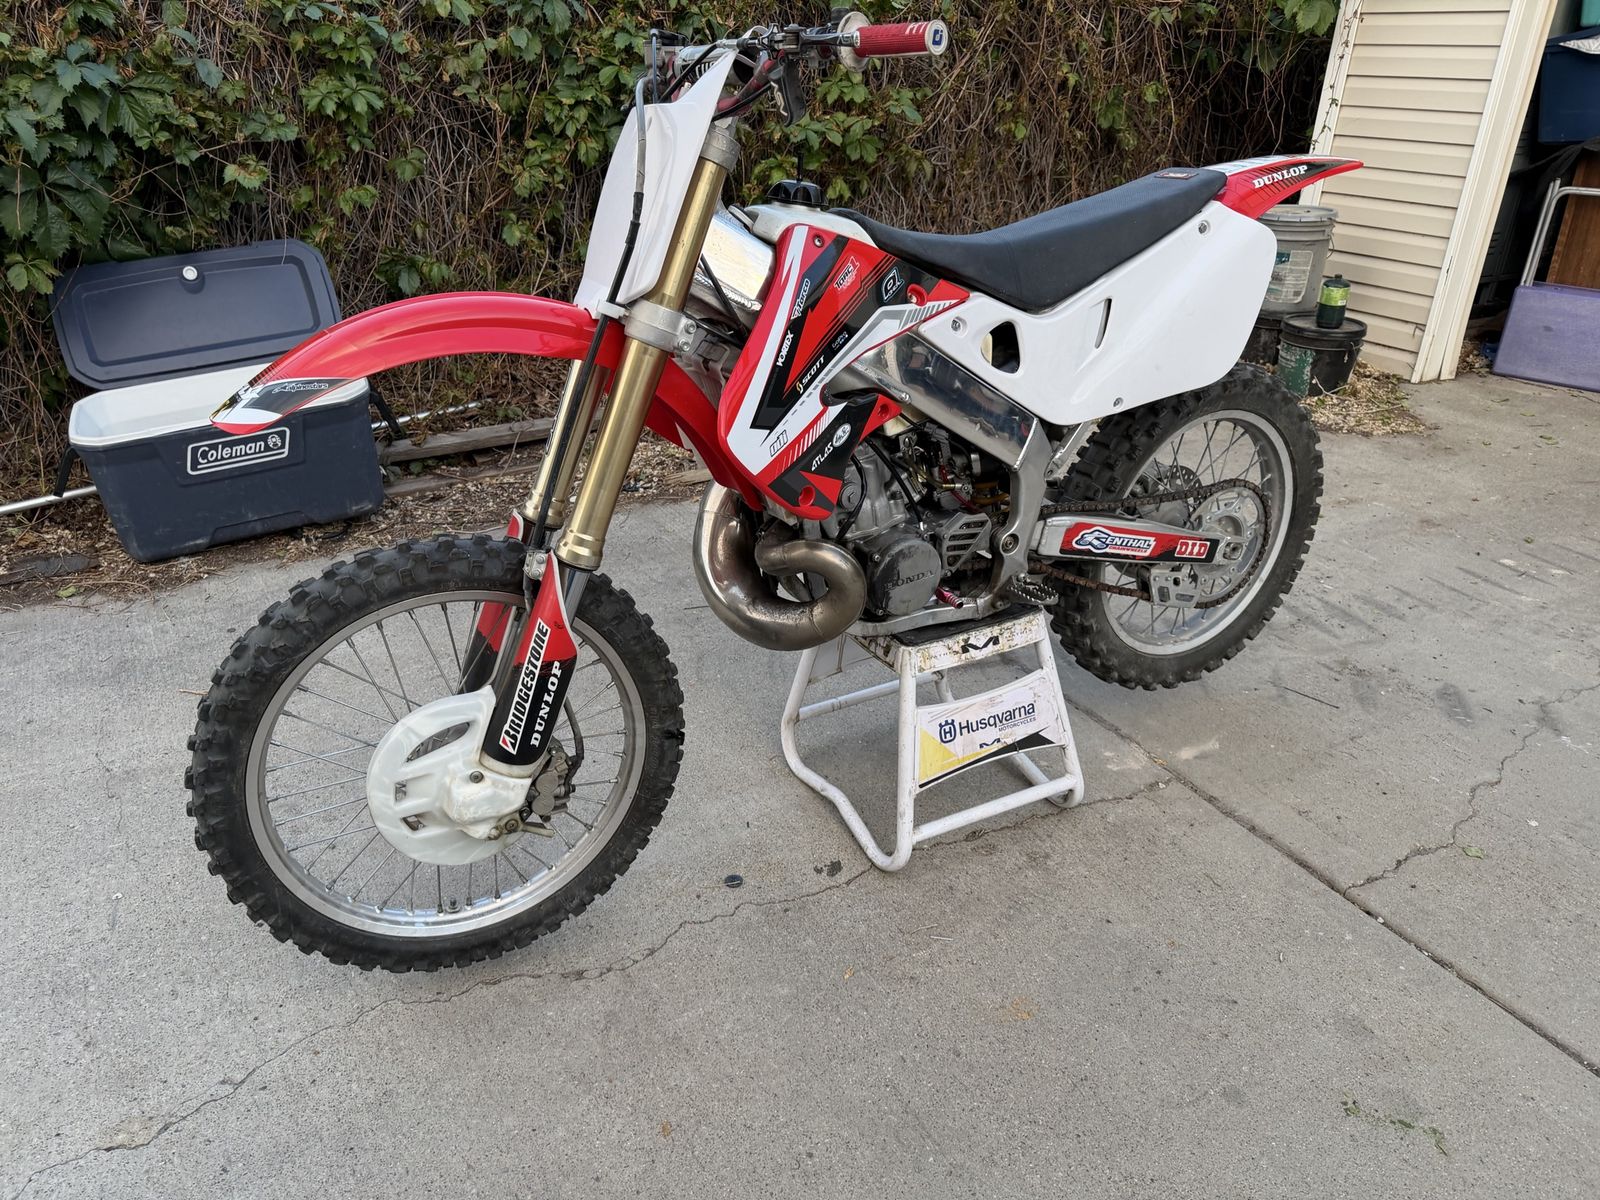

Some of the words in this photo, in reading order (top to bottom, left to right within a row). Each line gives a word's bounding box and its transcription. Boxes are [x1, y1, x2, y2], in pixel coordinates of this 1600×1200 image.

[1253, 165, 1308, 188] DUNLOP
[777, 331, 794, 367] VORTEX
[802, 356, 826, 385] SCOTT
[197, 440, 265, 464] Coleman
[811, 443, 834, 471] ATLAS
[501, 621, 550, 750] BRIDGESTONE
[530, 660, 563, 748] DUNLOP
[959, 702, 1036, 737] Husqvarna
[998, 716, 1037, 733] MOTORCYCLES
